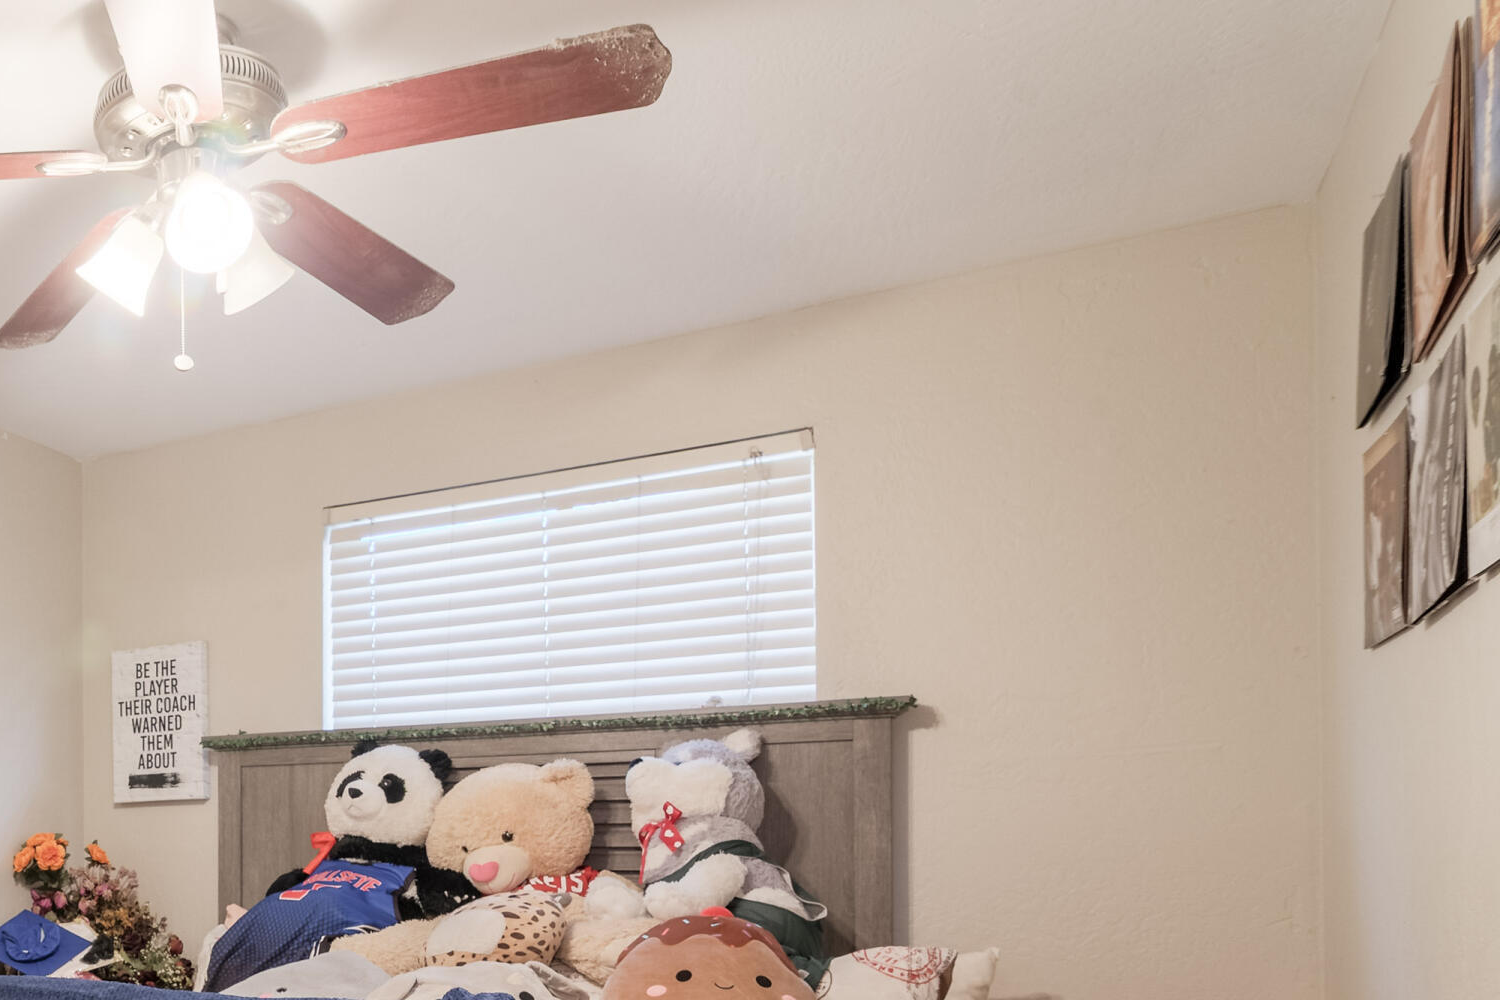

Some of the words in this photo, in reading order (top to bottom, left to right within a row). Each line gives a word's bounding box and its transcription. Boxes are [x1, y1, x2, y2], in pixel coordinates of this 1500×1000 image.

[135, 662, 151, 679] BE
[154, 659, 176, 677] THE
[134, 678, 178, 697] PLAYER
[118, 699, 152, 717] THEIR
[156, 694, 196, 714] COACH
[131, 714, 182, 734] WARNED
[140, 734, 173, 751] THEM
[138, 752, 177, 770] ABOUT
